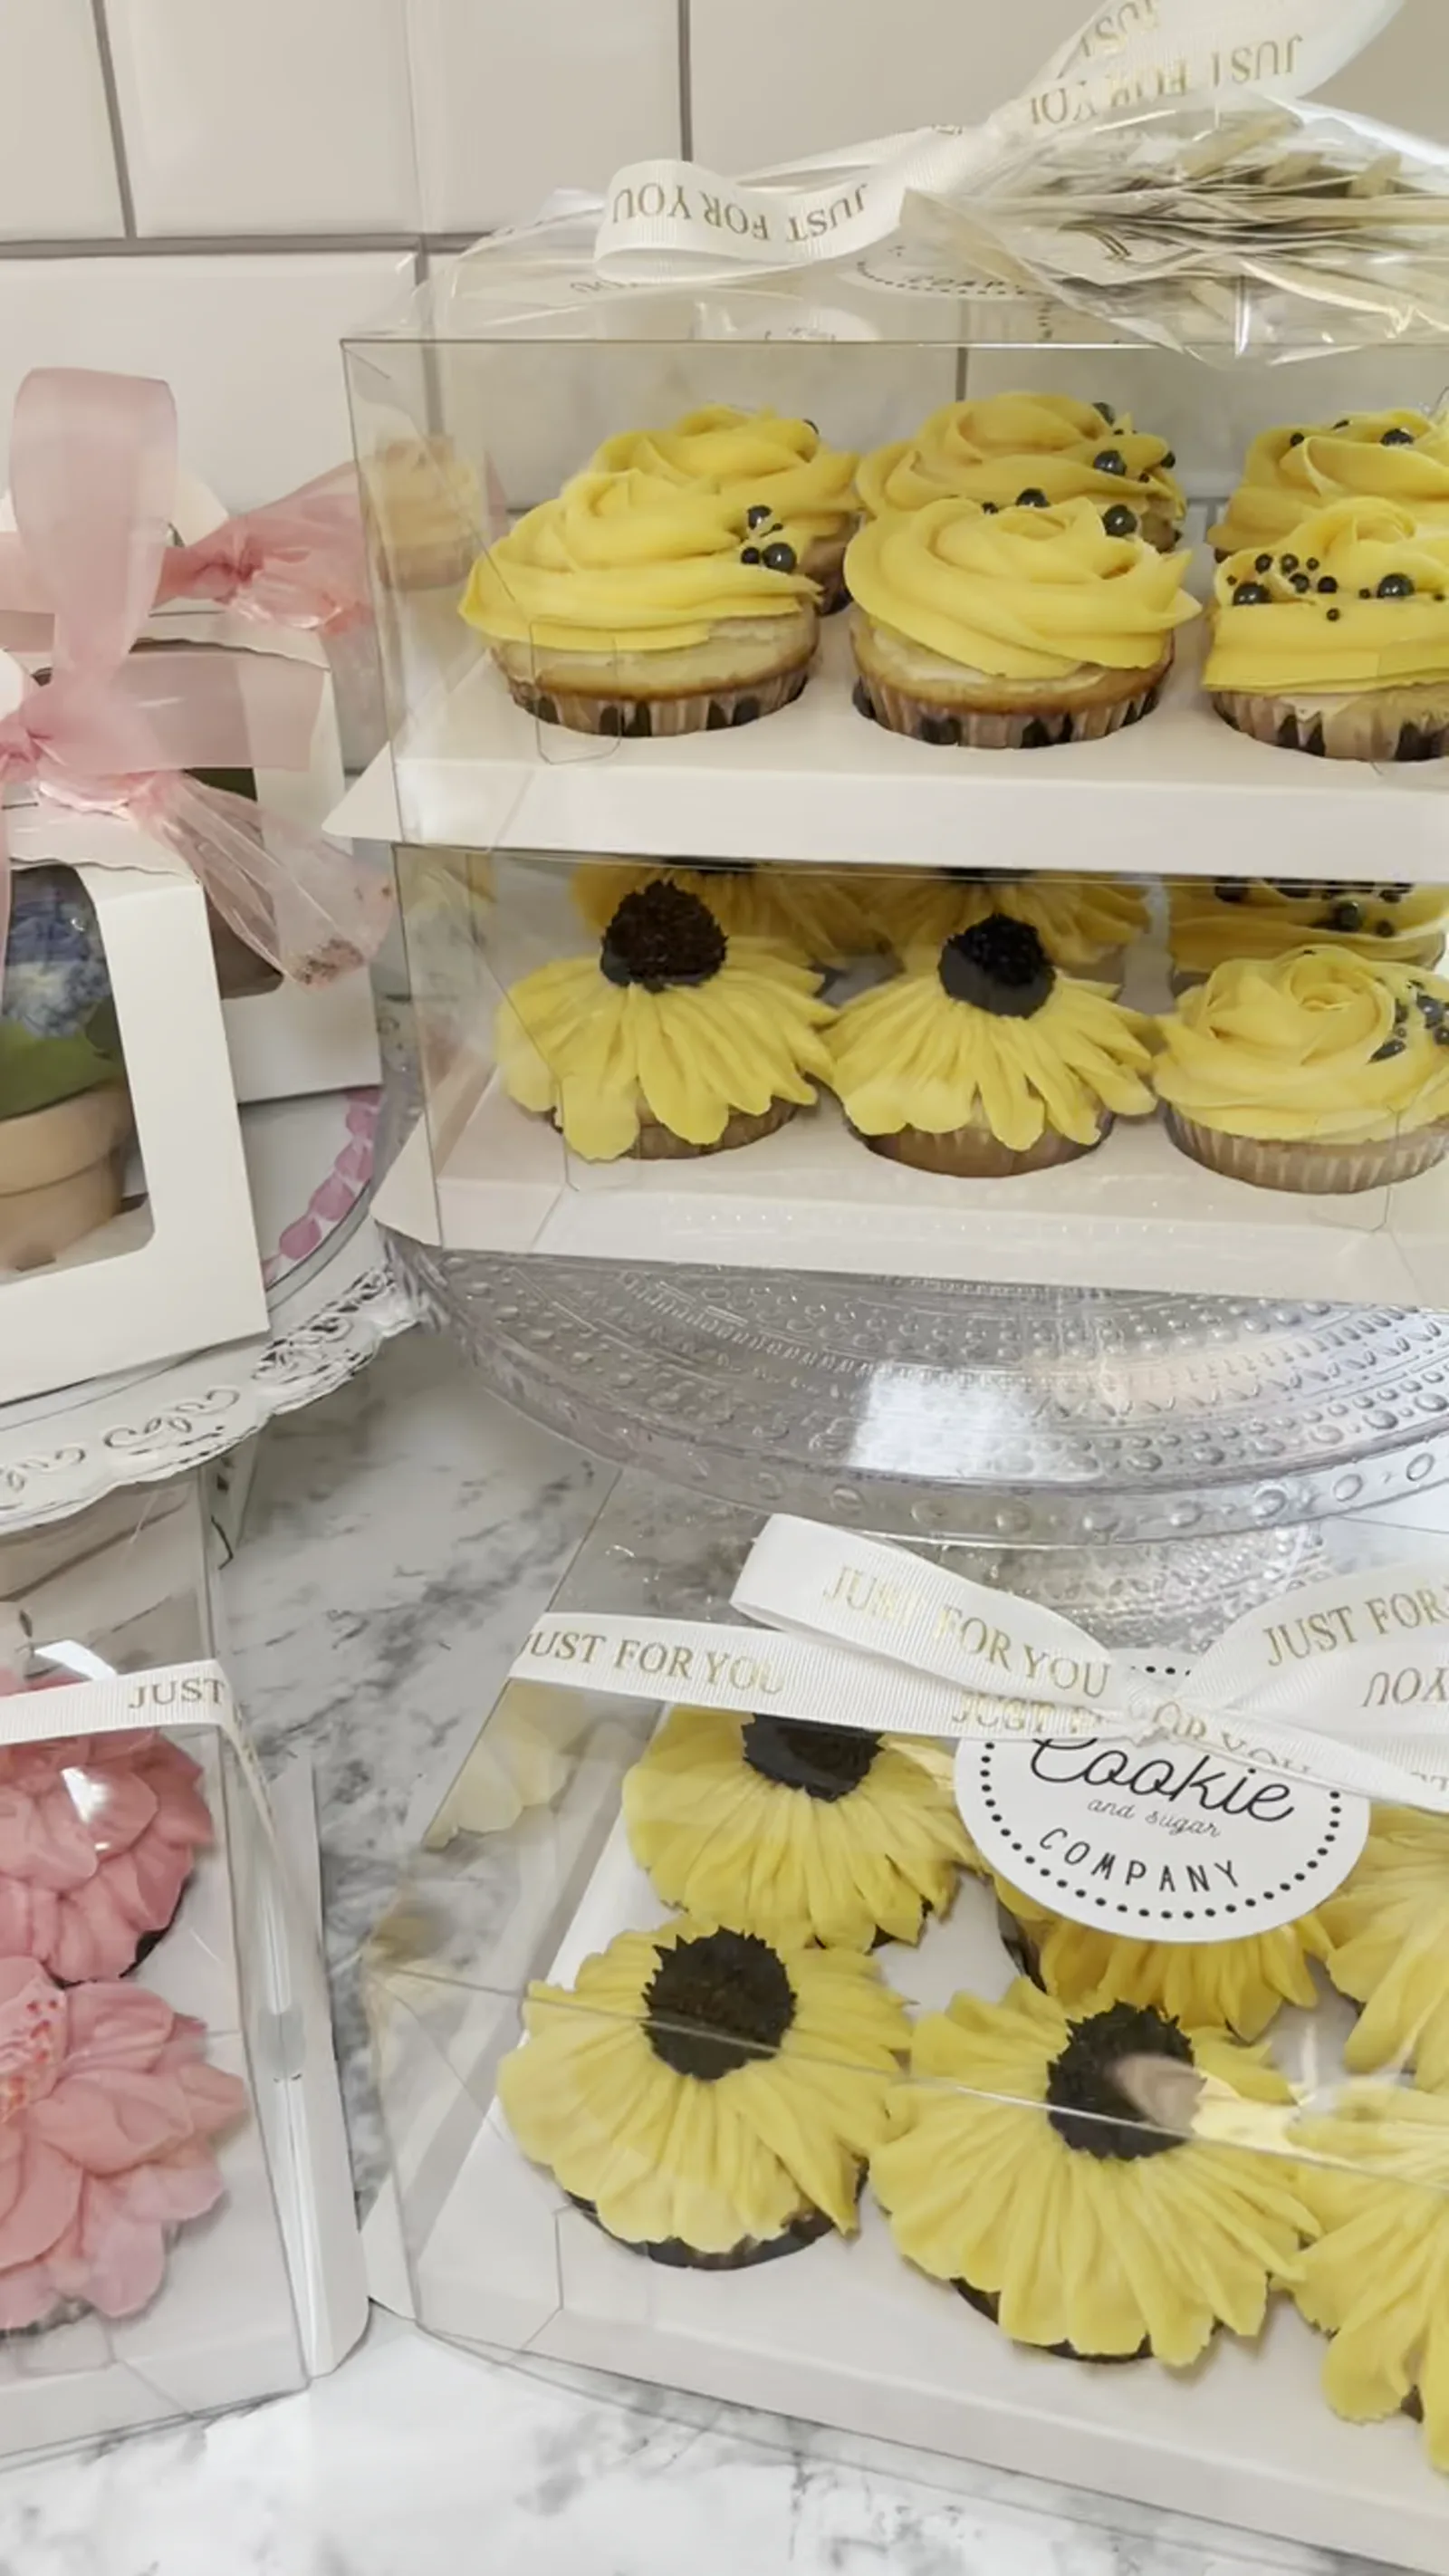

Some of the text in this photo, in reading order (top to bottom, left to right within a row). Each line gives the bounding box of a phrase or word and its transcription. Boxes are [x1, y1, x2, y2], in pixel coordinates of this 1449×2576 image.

[611, 182, 868, 243] JUST FOR YOU
[933, 1603, 1012, 1672] FOR
[1023, 1643, 1110, 1698] YOU
[1263, 1589, 1449, 1668] JUST FOR
[128, 1677, 226, 1709] JUST
[523, 1630, 784, 1696] UST FOR YOU
[1362, 1667, 1449, 1708] YOU
[1031, 1737, 1295, 1822] Cookie
[1087, 1796, 1221, 1839] and sugar
[1040, 1828, 1240, 1893] COMPANY
